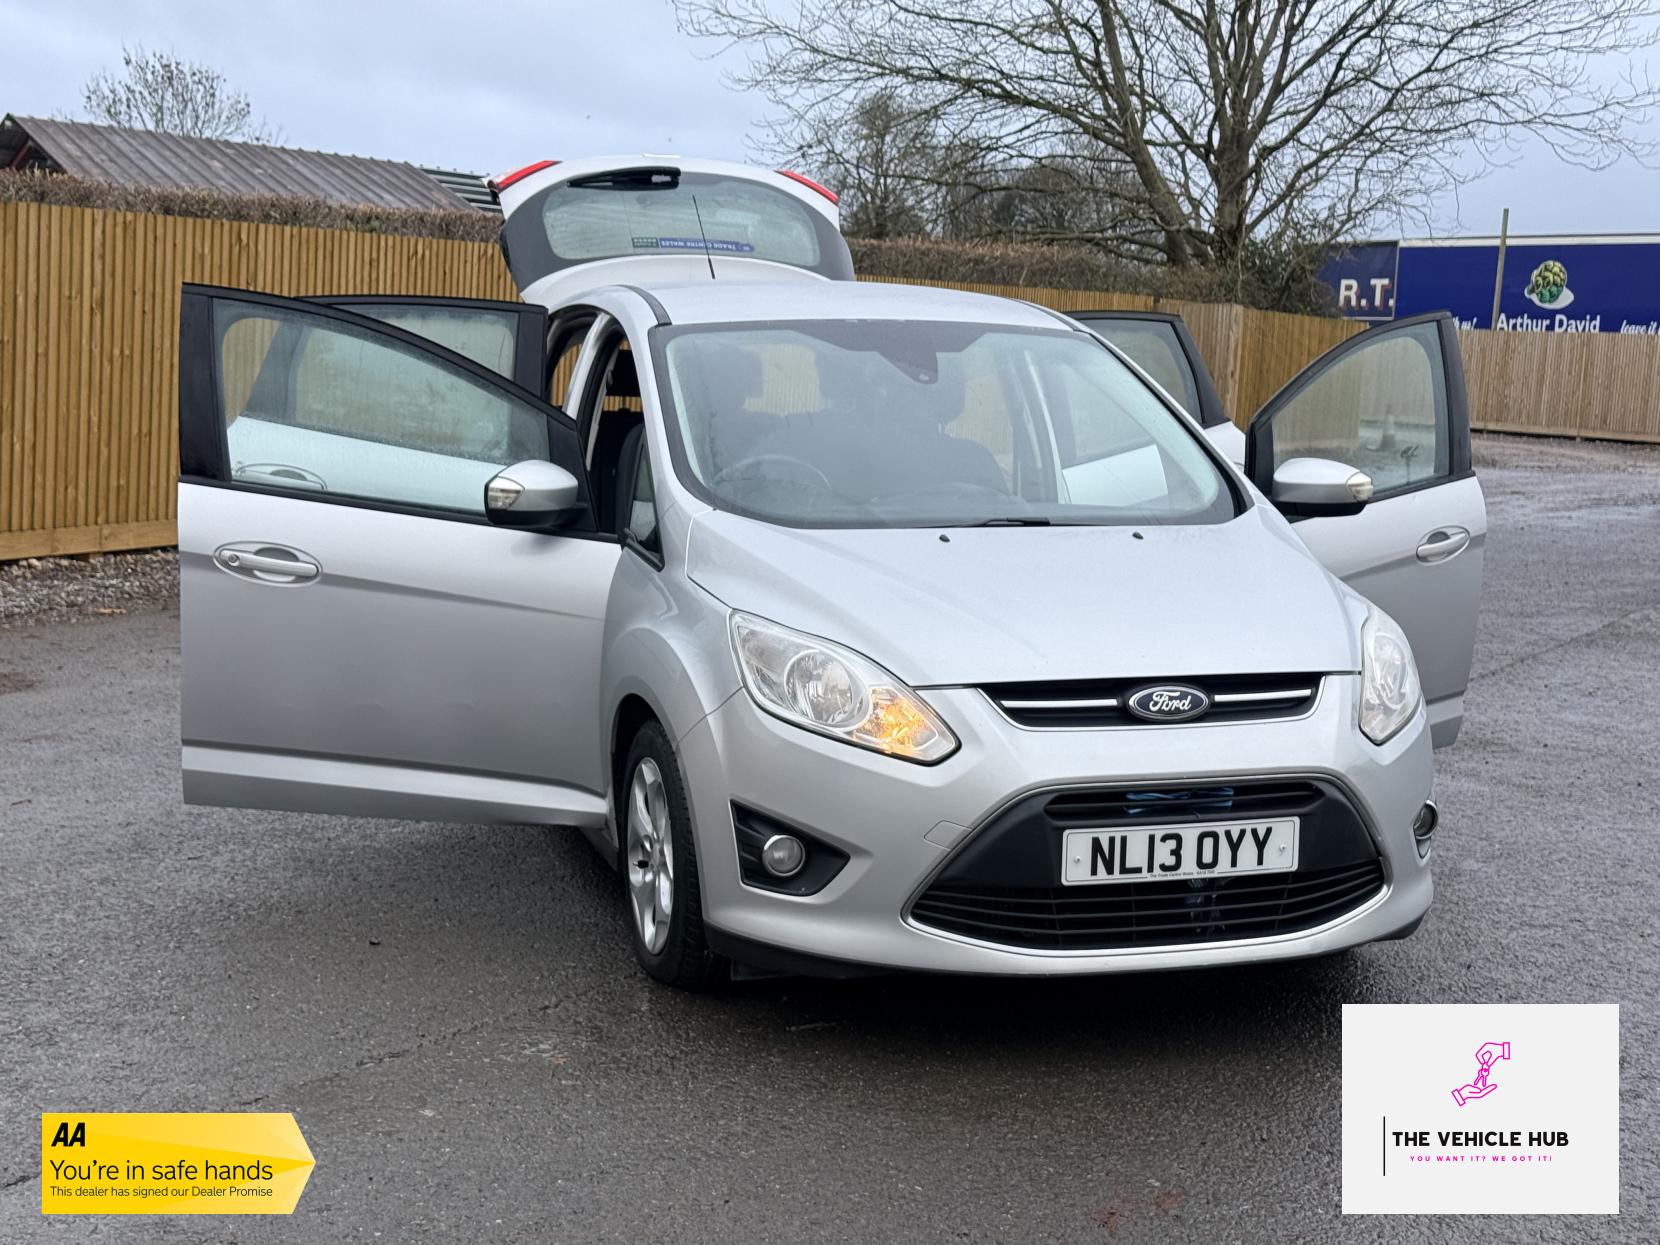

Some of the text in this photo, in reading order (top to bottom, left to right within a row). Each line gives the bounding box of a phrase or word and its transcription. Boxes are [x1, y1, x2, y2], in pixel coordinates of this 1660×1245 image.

[1339, 278, 1394, 307] R.T.
[1497, 313, 1600, 333] Arthur David
[1149, 691, 1191, 711] Ford
[1090, 826, 1273, 877] NL13 OYY
